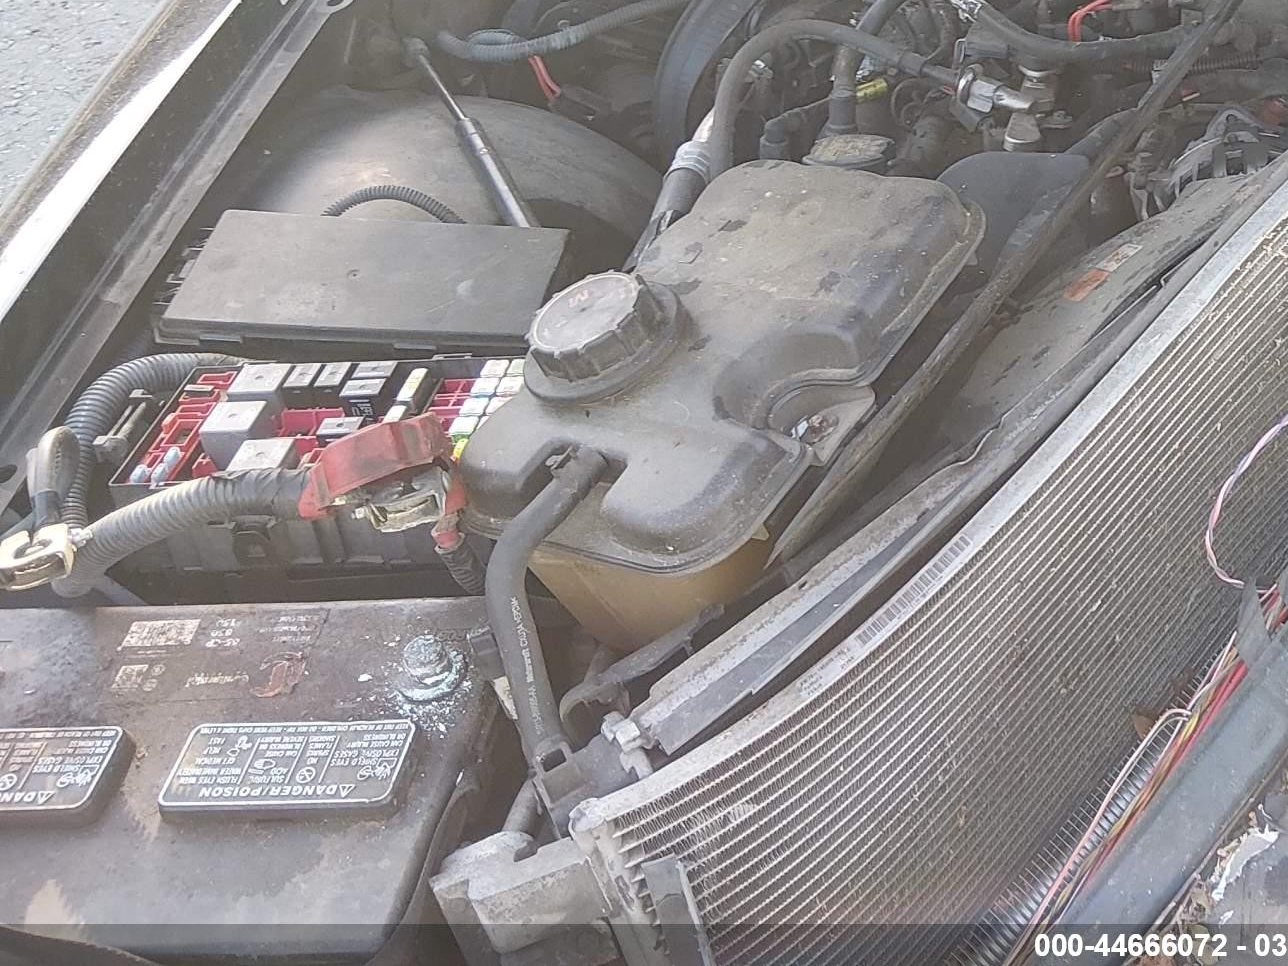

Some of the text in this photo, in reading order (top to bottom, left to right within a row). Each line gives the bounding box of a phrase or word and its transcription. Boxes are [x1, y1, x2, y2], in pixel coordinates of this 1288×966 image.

[208, 737, 226, 745] FAST
[362, 733, 396, 741] BLINDNESS
[333, 749, 400, 758] EXPLOSIVE GASES
[330, 757, 378, 766] SHIELD EYES
[198, 776, 215, 784] EYES
[216, 776, 238, 784] FLUSH
[198, 784, 338, 797] DANGER/POISON
